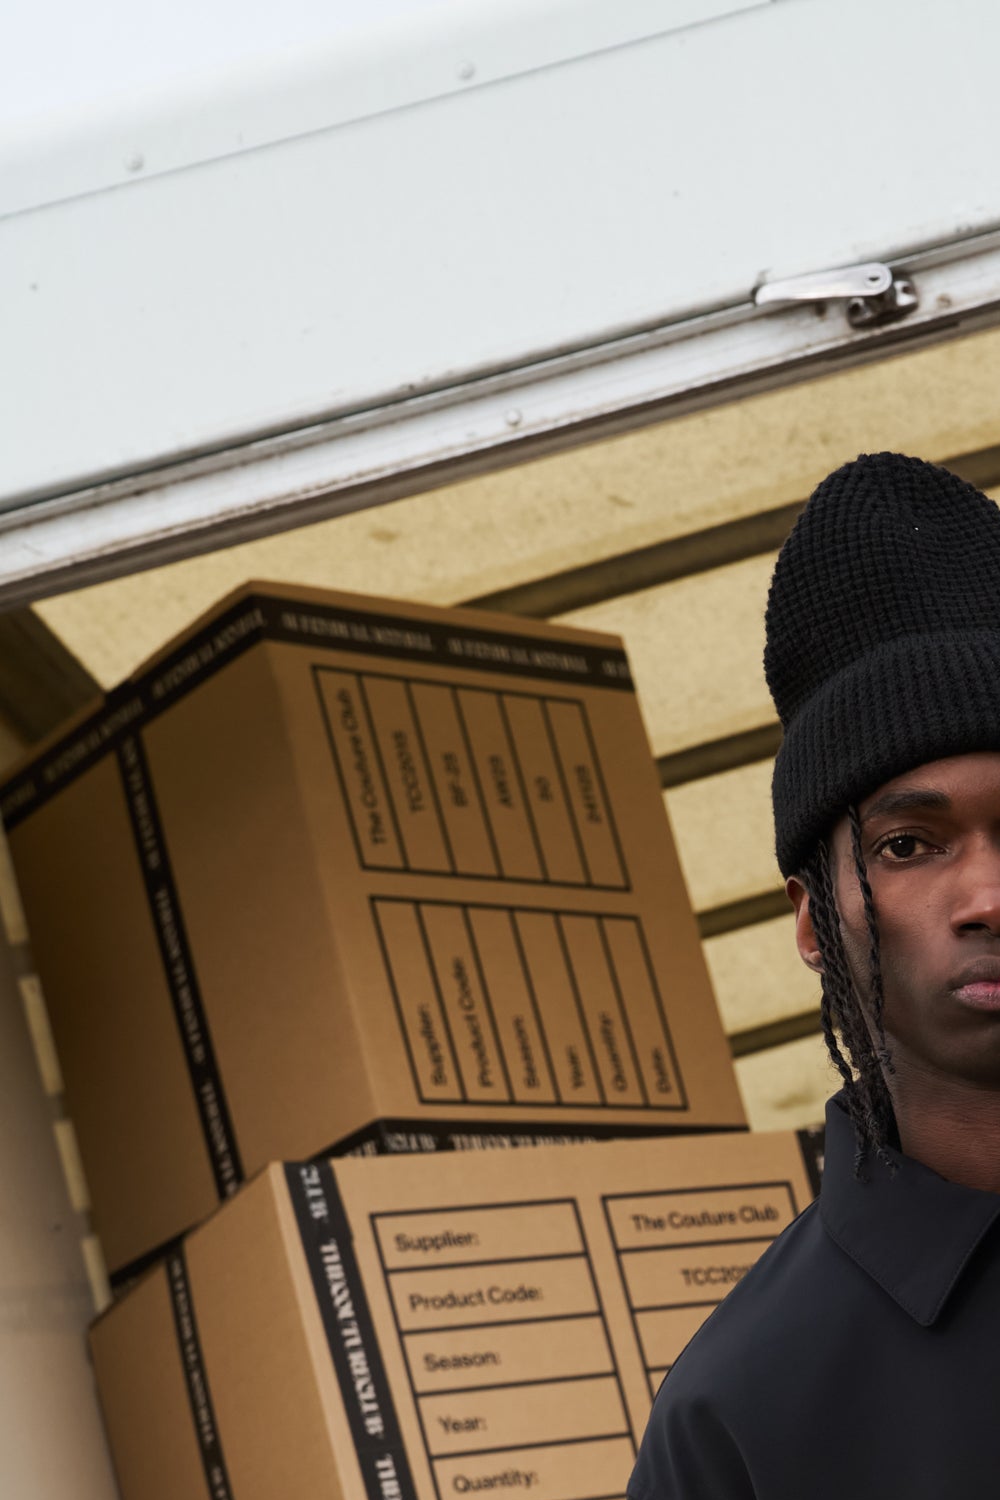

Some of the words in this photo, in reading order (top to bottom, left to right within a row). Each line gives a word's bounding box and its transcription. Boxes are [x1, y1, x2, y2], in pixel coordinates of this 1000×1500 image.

[630, 1213, 667, 1232] The
[667, 1210, 737, 1230] Couture
[738, 1205, 780, 1223] Club
[394, 1230, 479, 1254] Supplier:
[407, 1289, 484, 1313] Product
[486, 1283, 543, 1305] Code:
[423, 1350, 501, 1373] Season:
[438, 1415, 487, 1434] Year:
[453, 1469, 539, 1494] Quantity:
